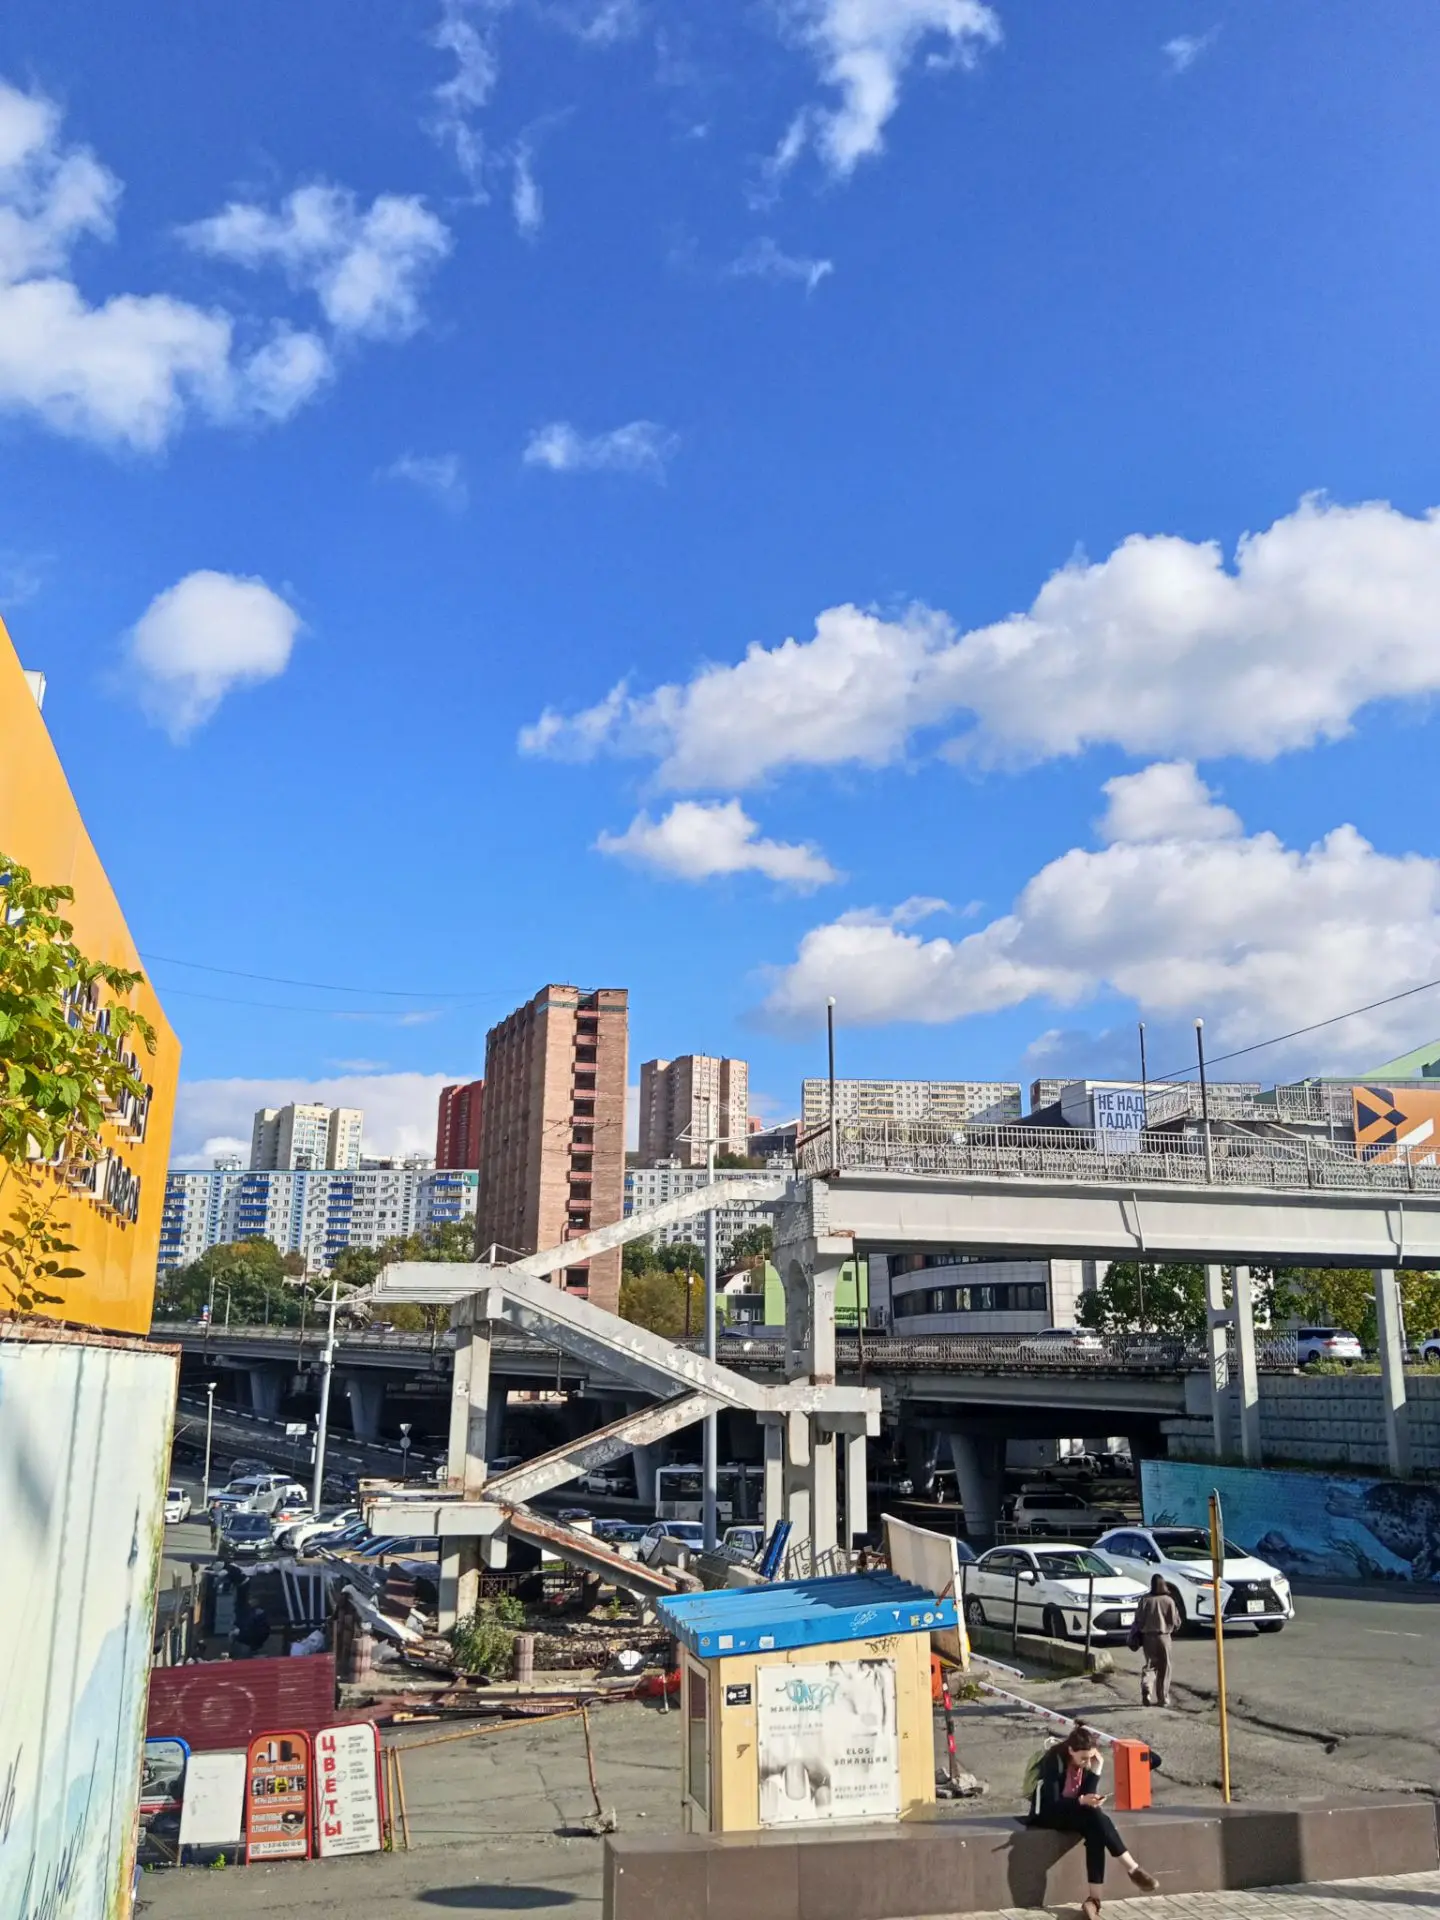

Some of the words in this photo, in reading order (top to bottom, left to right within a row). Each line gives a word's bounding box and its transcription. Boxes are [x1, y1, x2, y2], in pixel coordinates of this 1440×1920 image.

[1098, 1094, 1114, 1110] НЕ
[1117, 1095, 1145, 1113] НАД
[1099, 1111, 1146, 1130] ГАДАТЬ
[321, 1735, 342, 1837] ЦВЕТЫ
